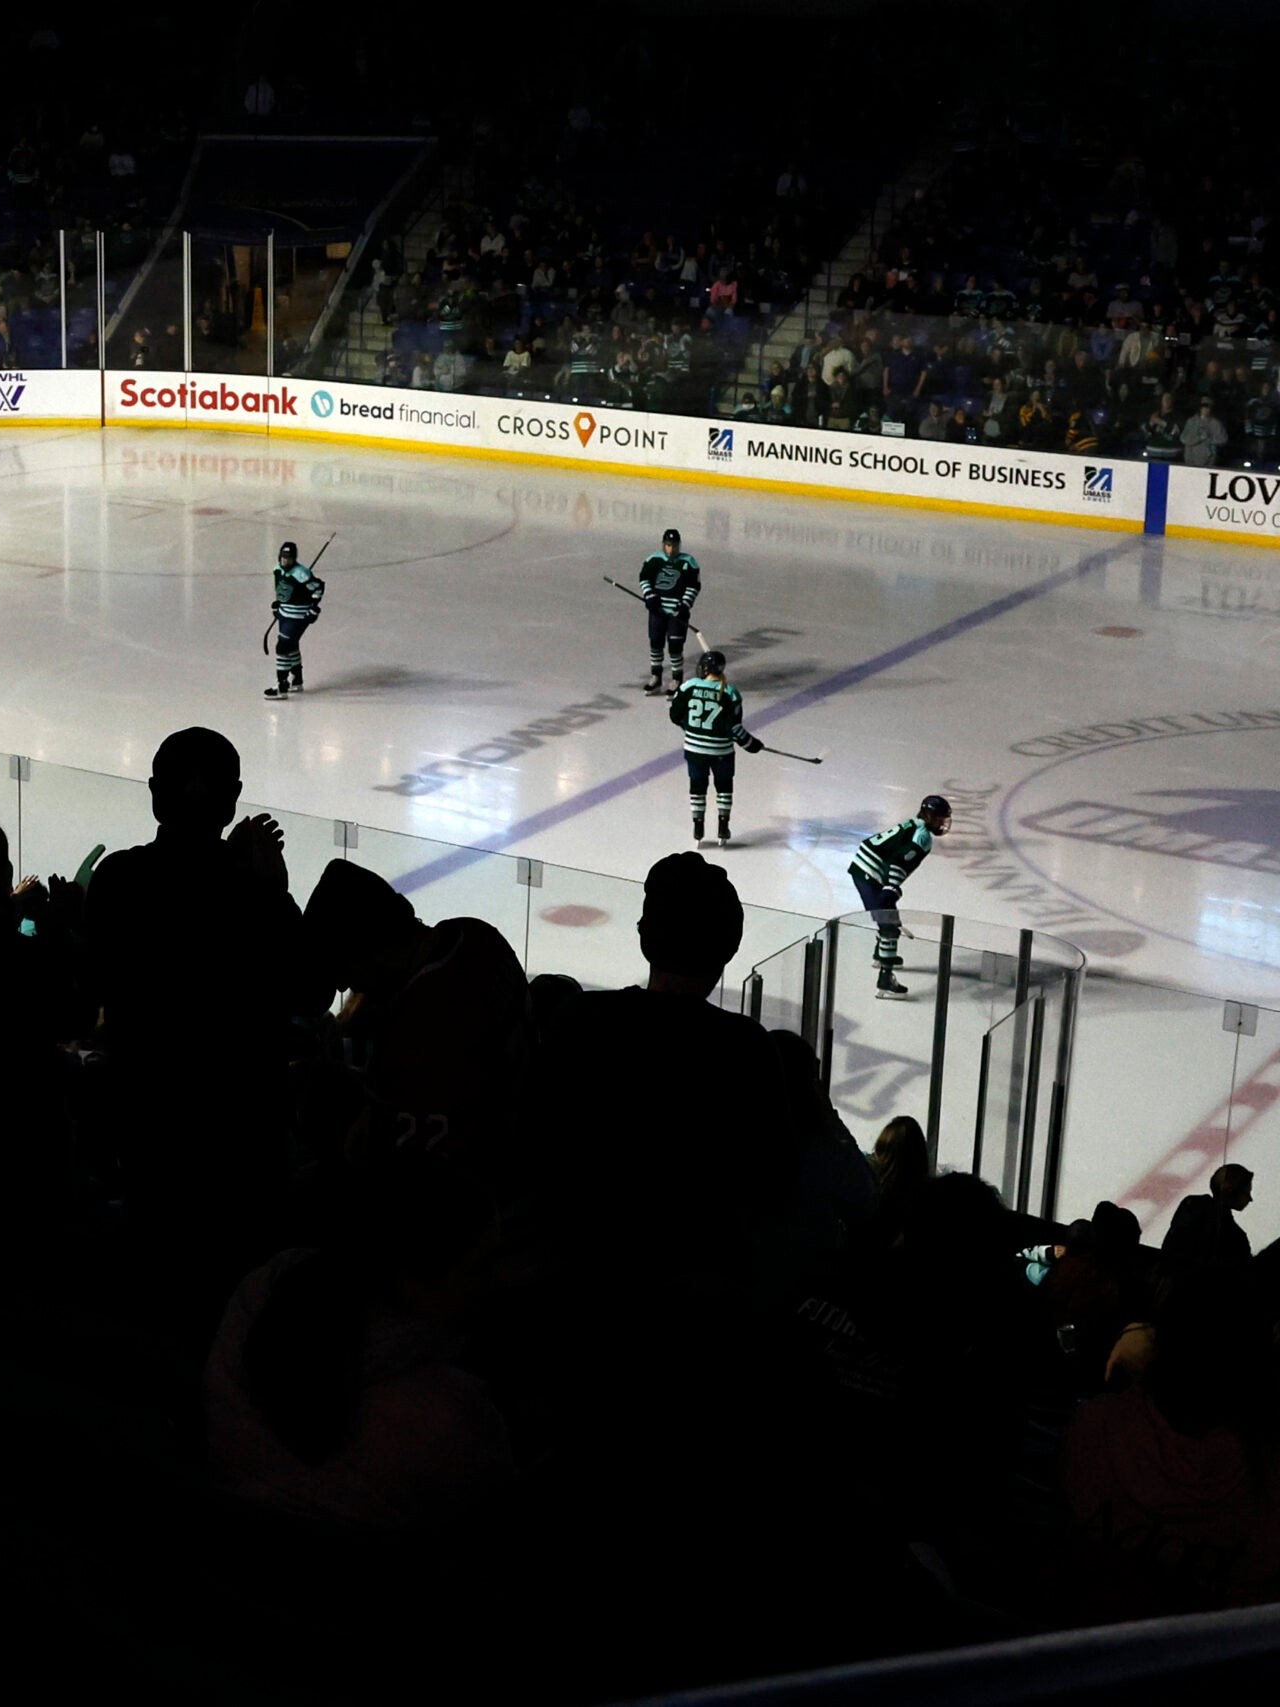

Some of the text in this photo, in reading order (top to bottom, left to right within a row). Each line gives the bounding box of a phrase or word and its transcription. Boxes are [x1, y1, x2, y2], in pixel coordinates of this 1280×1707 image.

[120, 379, 298, 416] Scotiabank
[339, 399, 394, 420] bread
[498, 415, 669, 450] CROSS POINT
[747, 440, 1066, 490] MANNING SCHOOL OF BUSINESS
[1206, 505, 1266, 526] VOLVO
[688, 698, 723, 730] 27
[1009, 716, 1187, 757] CREDIT
